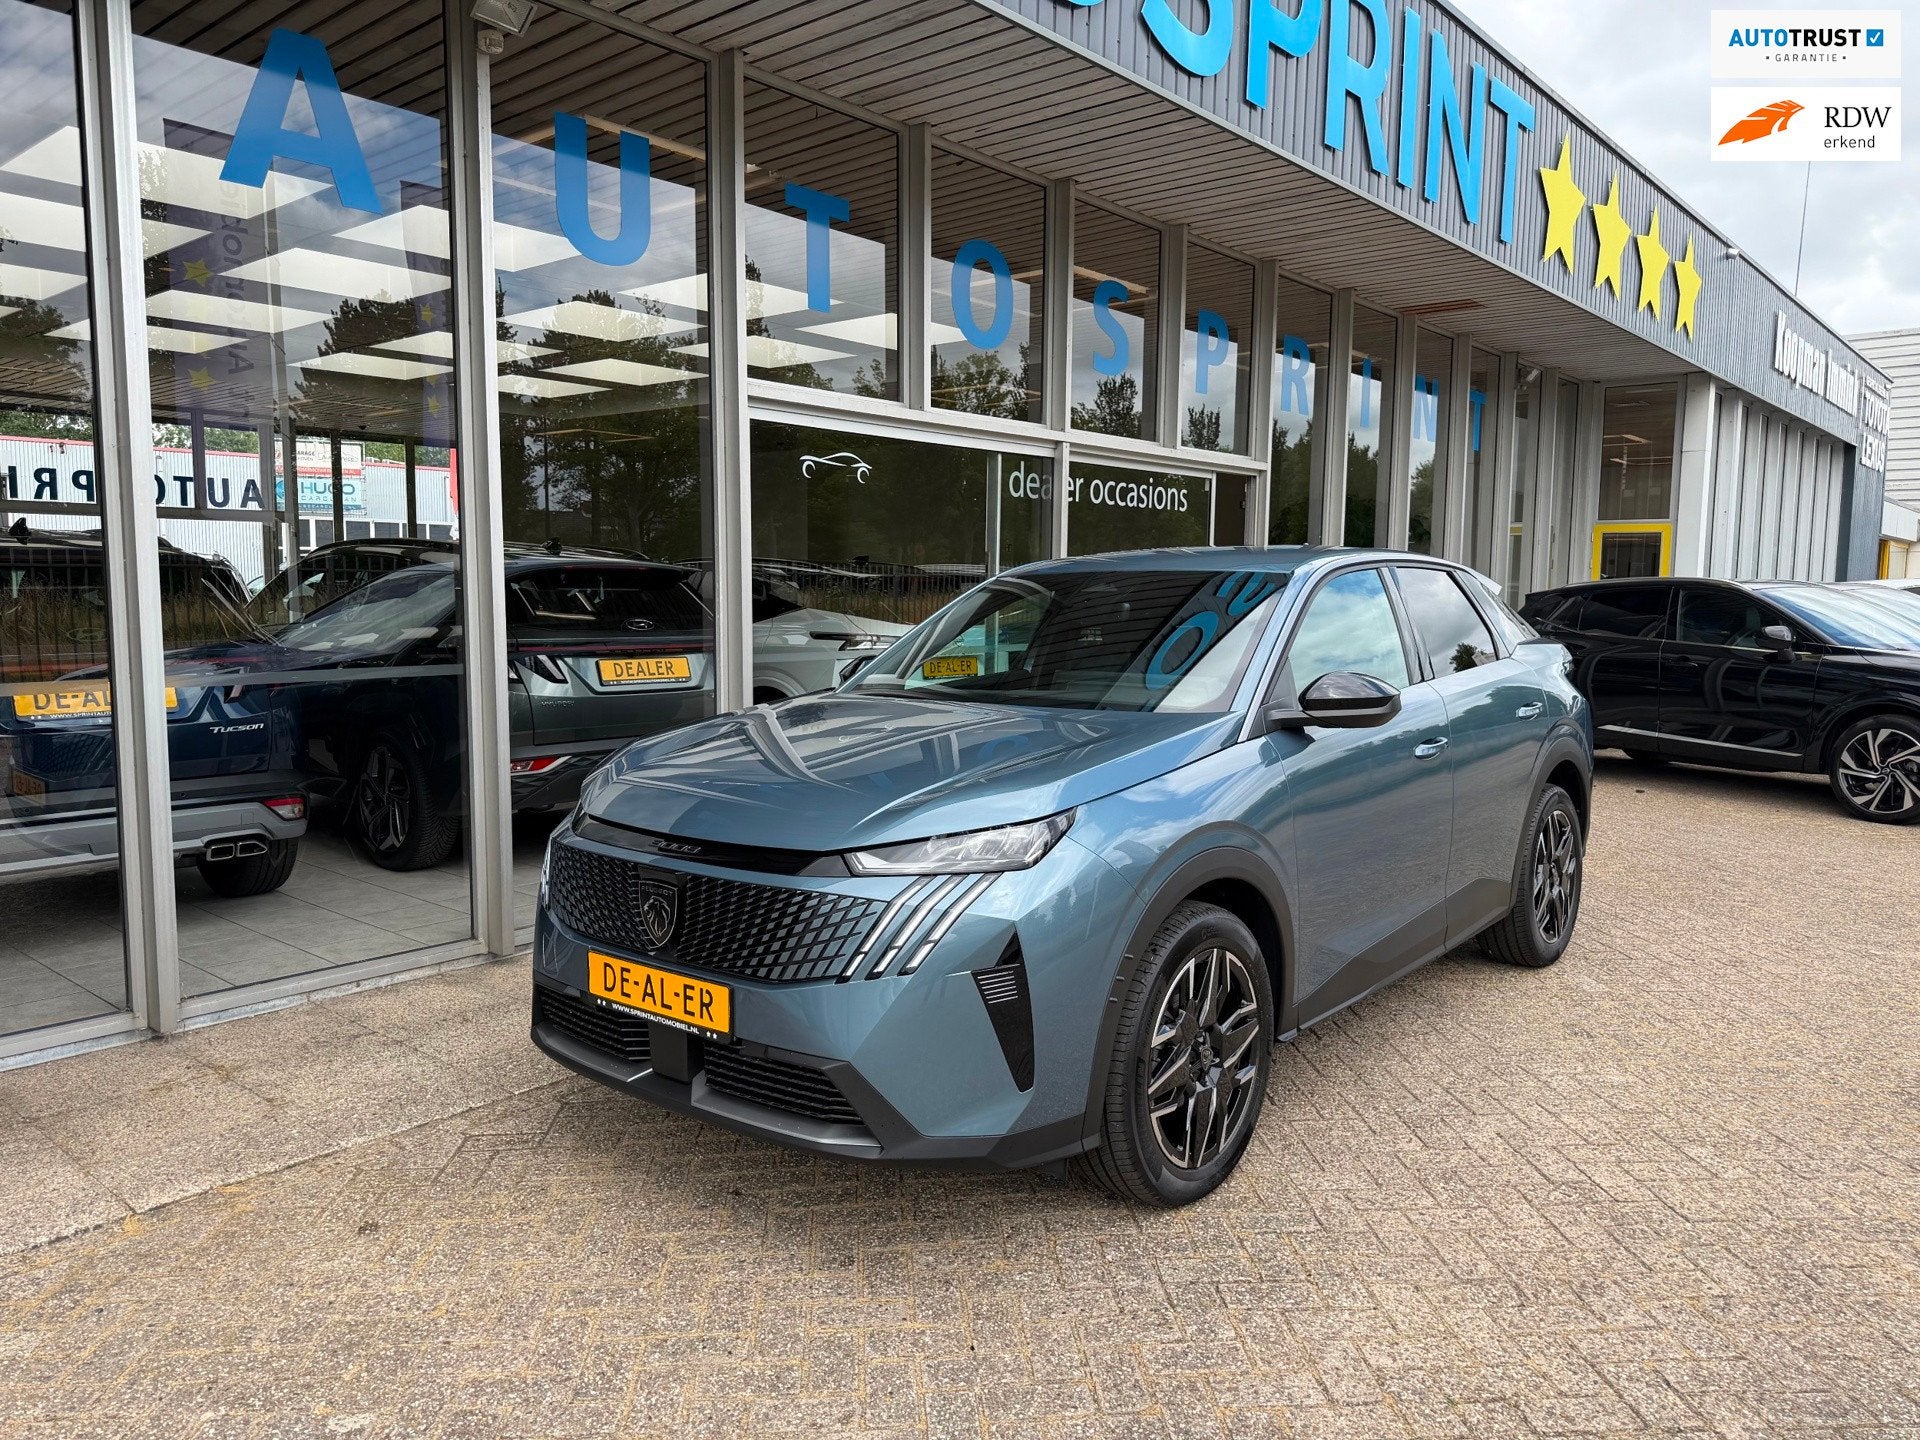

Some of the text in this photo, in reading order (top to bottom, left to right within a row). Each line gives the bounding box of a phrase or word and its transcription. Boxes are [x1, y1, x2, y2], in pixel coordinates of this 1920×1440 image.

[1861, 432, 1886, 473] LEXUS
[301, 481, 355, 495] HUO
[1009, 461, 1188, 512] deaer occasions
[301, 495, 356, 503] CARCAN
[613, 661, 675, 678] DEALER
[929, 660, 972, 674] DE-AL-ER
[33, 686, 111, 710] DE-AL
[604, 961, 714, 1023] DE-AL-ER
[611, 1002, 700, 1035] WWW.SPRINTAUTOMOBIEL.NL
